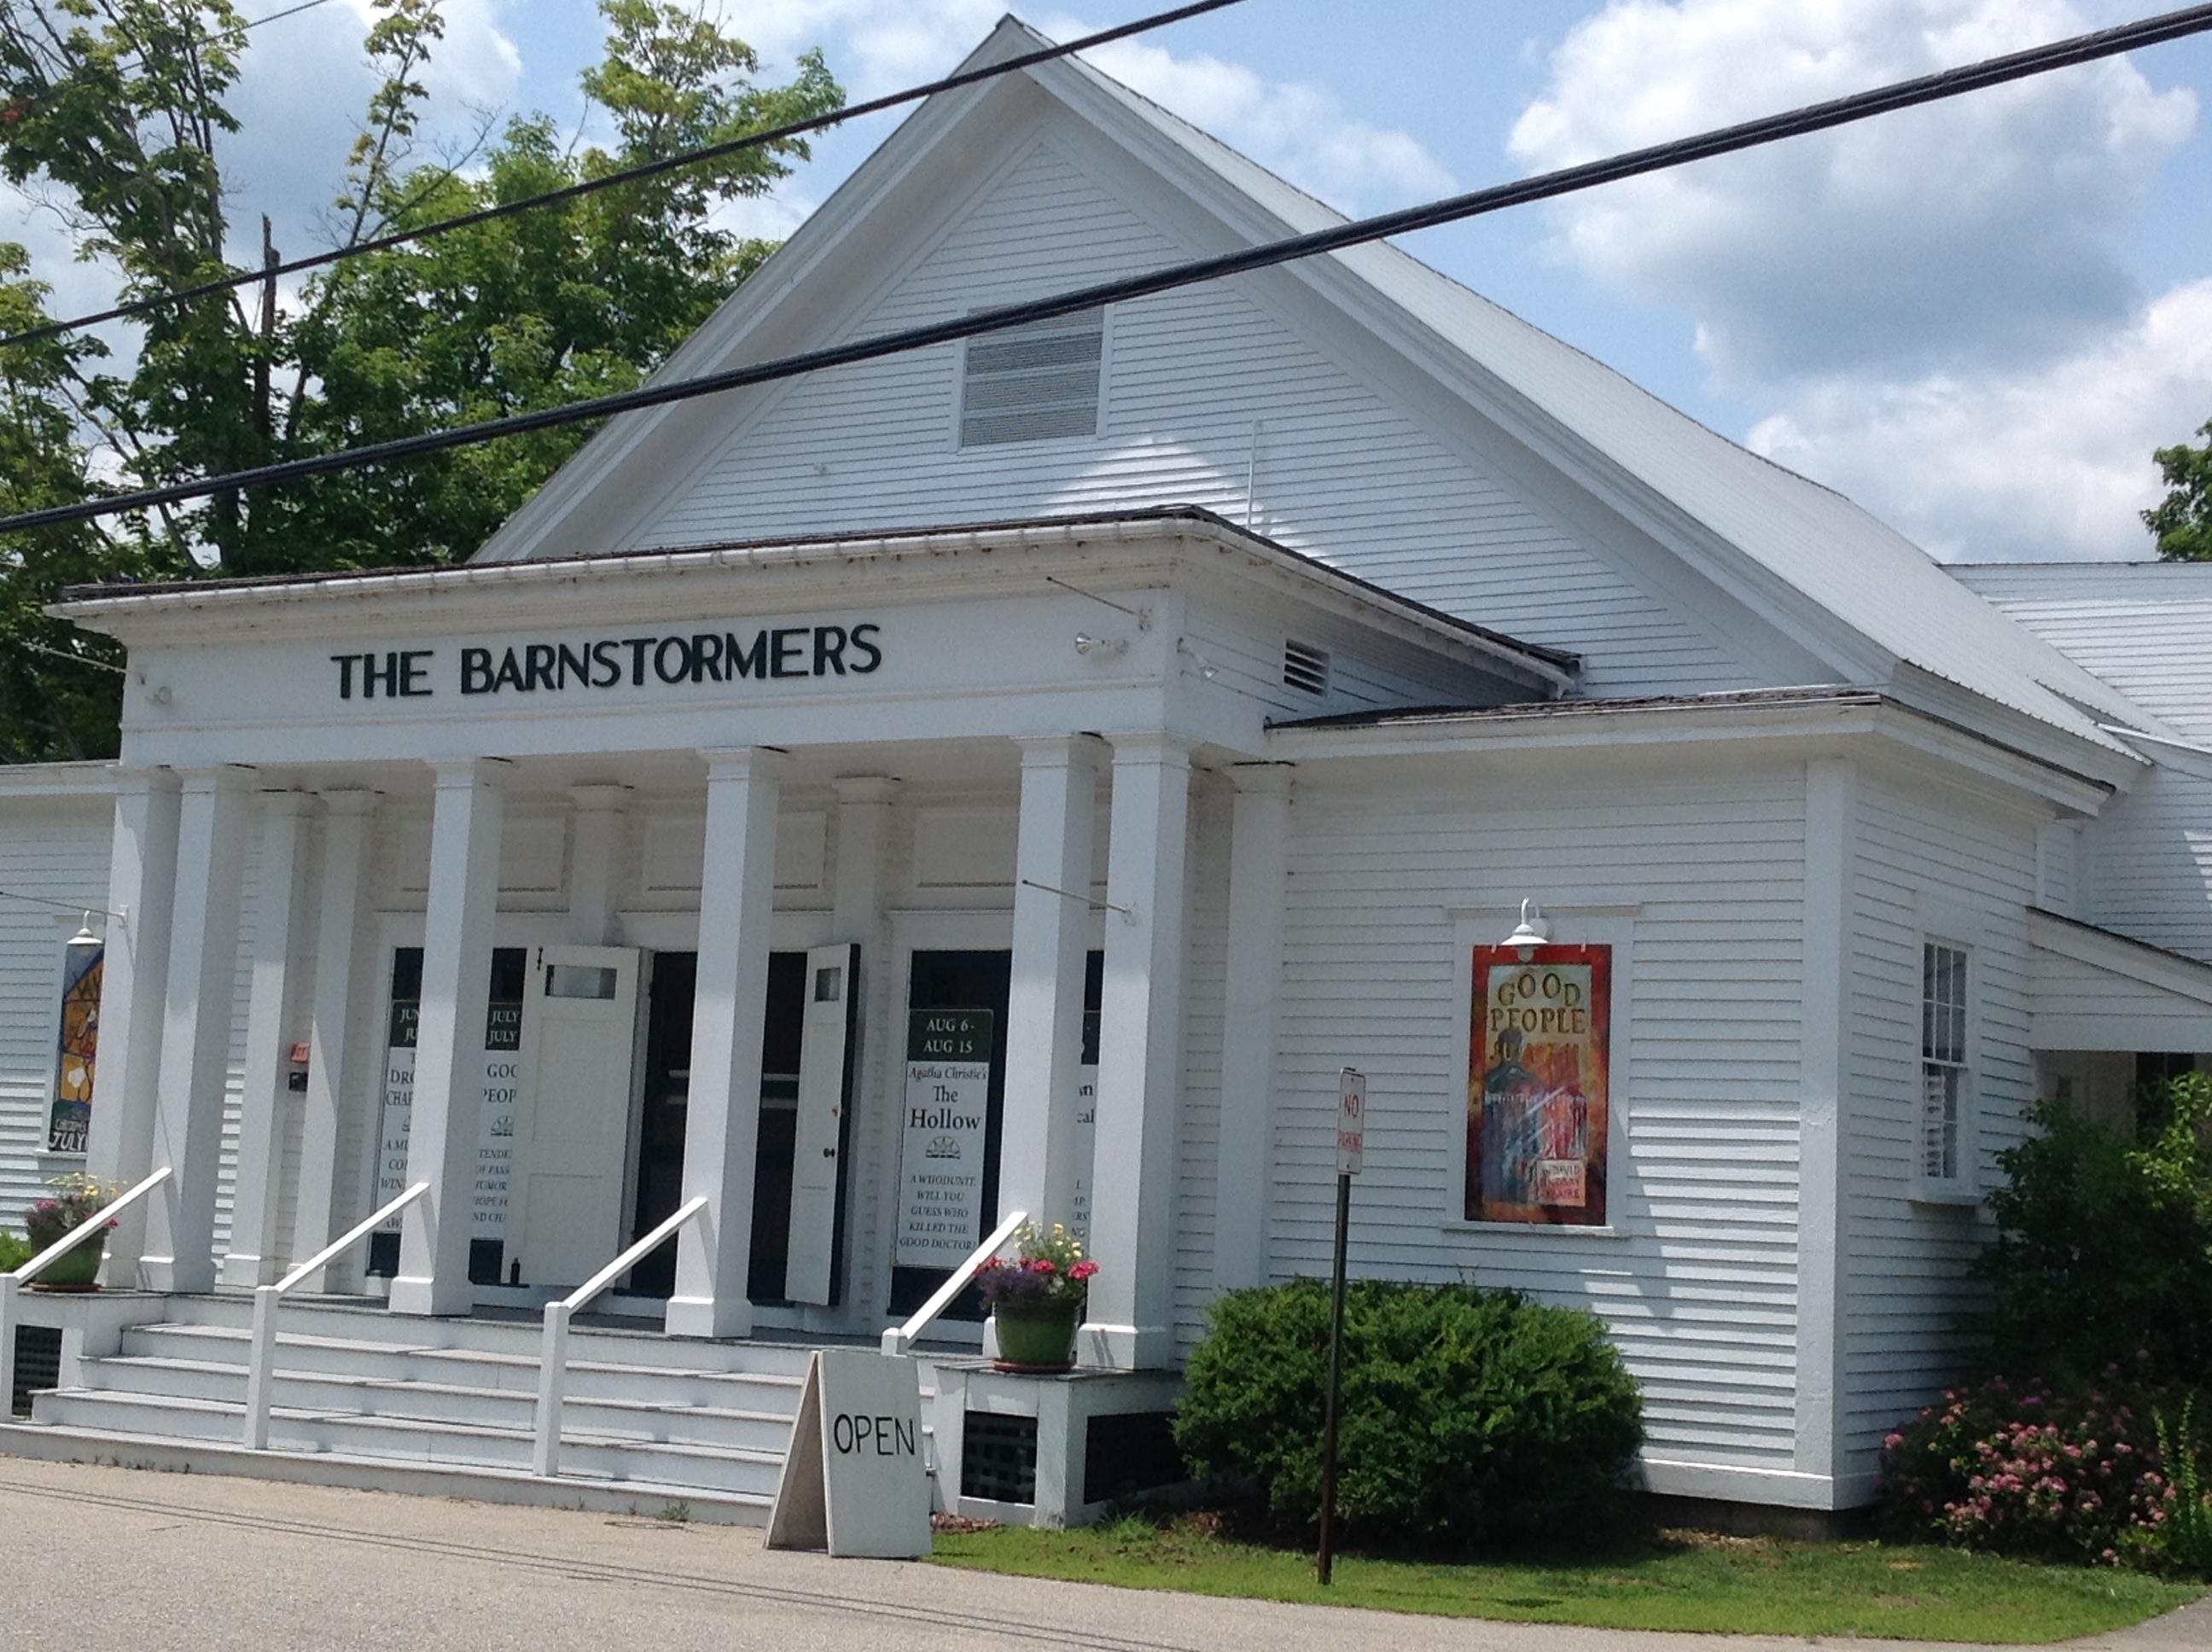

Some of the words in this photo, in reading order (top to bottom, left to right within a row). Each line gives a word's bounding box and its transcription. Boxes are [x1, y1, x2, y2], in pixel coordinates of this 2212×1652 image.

[330, 650, 434, 699] THE
[460, 624, 882, 695] BARNSTORMERS
[1498, 973, 1580, 1007] GOOD
[399, 1008, 421, 1024] JUN
[491, 1009, 521, 1025] JULY
[1490, 1008, 1586, 1034] PEOPLE
[926, 1018, 956, 1032] AUG
[403, 1027, 418, 1043] JU
[488, 1030, 517, 1044] JULY
[923, 1039, 953, 1053] AUG
[959, 1039, 973, 1054] 15
[910, 1065, 942, 1082] Agatha
[944, 1066, 988, 1080] Christie's
[483, 1088, 517, 1103] EOP
[932, 1085, 958, 1103] The
[1344, 1093, 1360, 1119] NO
[910, 1108, 982, 1131] Hollow
[49, 1131, 86, 1152] JULY
[942, 1190, 965, 1202] YOU
[910, 1206, 942, 1218] GUESS
[944, 1207, 969, 1219] WHO
[908, 1222, 946, 1233] KILLED
[947, 1223, 969, 1235] THE
[899, 1237, 929, 1248] GOOD
[833, 1413, 916, 1456] OPEN
